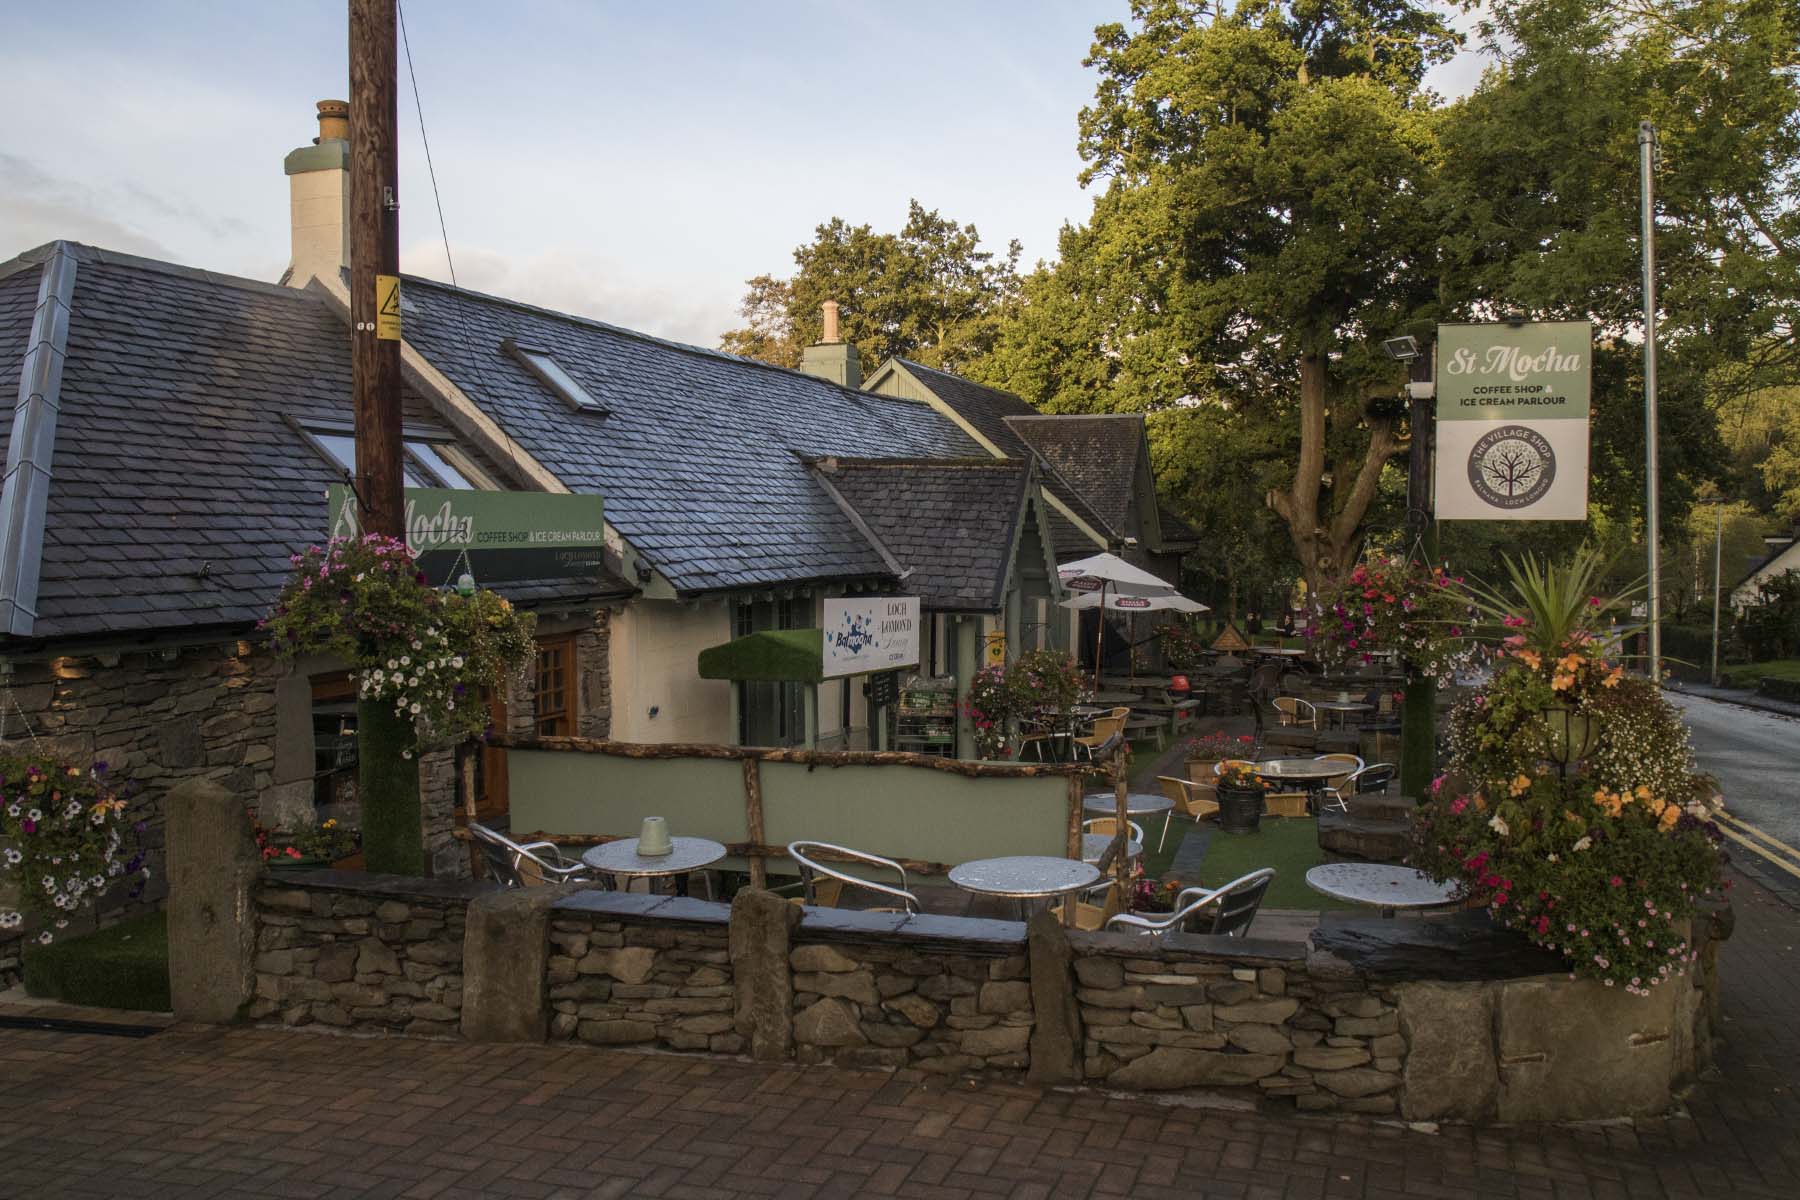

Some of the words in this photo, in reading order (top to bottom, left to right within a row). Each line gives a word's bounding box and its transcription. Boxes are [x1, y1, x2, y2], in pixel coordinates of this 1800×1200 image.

[1447, 347, 1479, 375] St
[1480, 345, 1581, 381] Mocha
[1473, 386, 1512, 394] COFFEE
[1514, 385, 1543, 393] SHOP
[1545, 384, 1553, 393] &
[1460, 398, 1476, 406] ICE
[1479, 398, 1514, 406] CREAM
[1517, 396, 1566, 405] PARLOUR
[1473, 441, 1488, 458] THE
[1487, 429, 1530, 442] VILLAGE
[1530, 435, 1551, 458] SHOP
[477, 531, 508, 542] COFFEE
[508, 531, 528, 542] SHOP
[529, 531, 535, 542] &
[535, 531, 546, 542] ICE
[546, 531, 572, 542] CREAM
[572, 531, 600, 541] PARLOUR
[887, 602, 907, 617] LOCH
[881, 619, 912, 634] LOMOND
